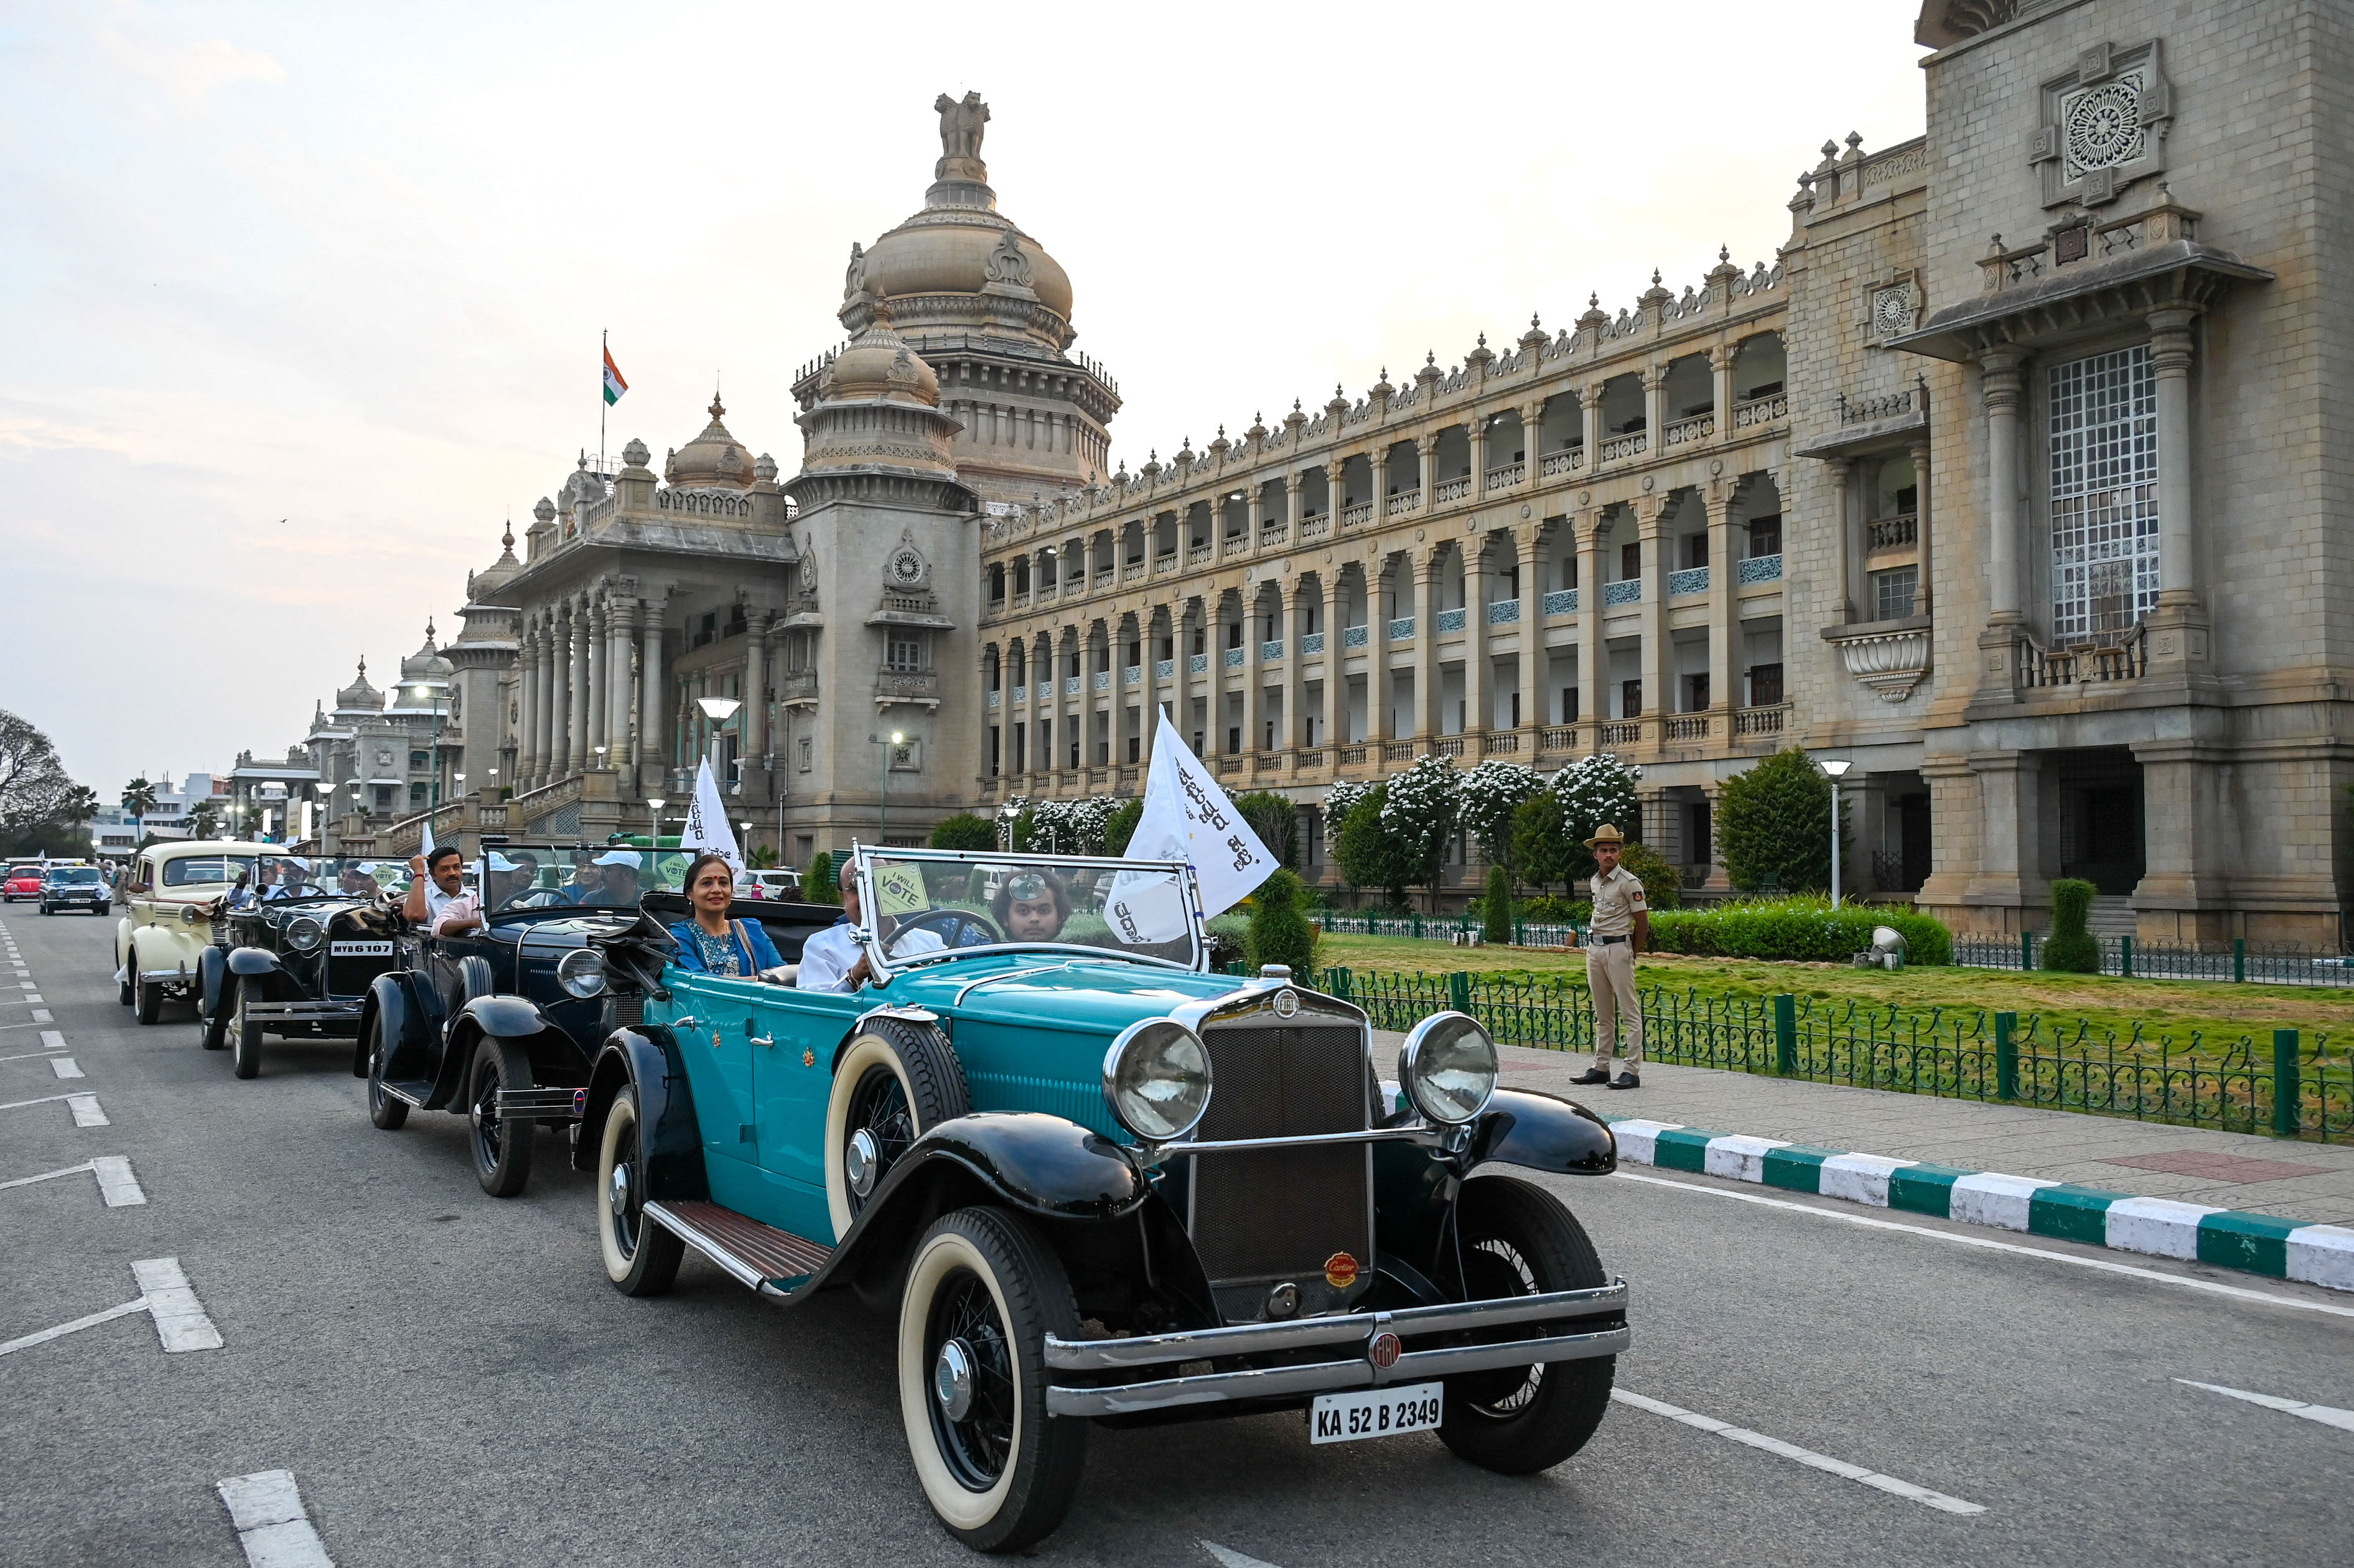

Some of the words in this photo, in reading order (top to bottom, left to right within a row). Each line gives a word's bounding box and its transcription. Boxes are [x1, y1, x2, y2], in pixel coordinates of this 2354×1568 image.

[882, 875, 920, 906] VOTE
[897, 874, 915, 890] WILL
[1279, 999, 1294, 1009] FIAT
[1329, 1261, 1355, 1271] Cartier
[1376, 1335, 1396, 1366] FIAT
[1318, 1410, 1342, 1437] KA
[1348, 1407, 1372, 1434] 52
[1378, 1405, 1390, 1430] B
[1396, 1398, 1439, 1428] 2349
